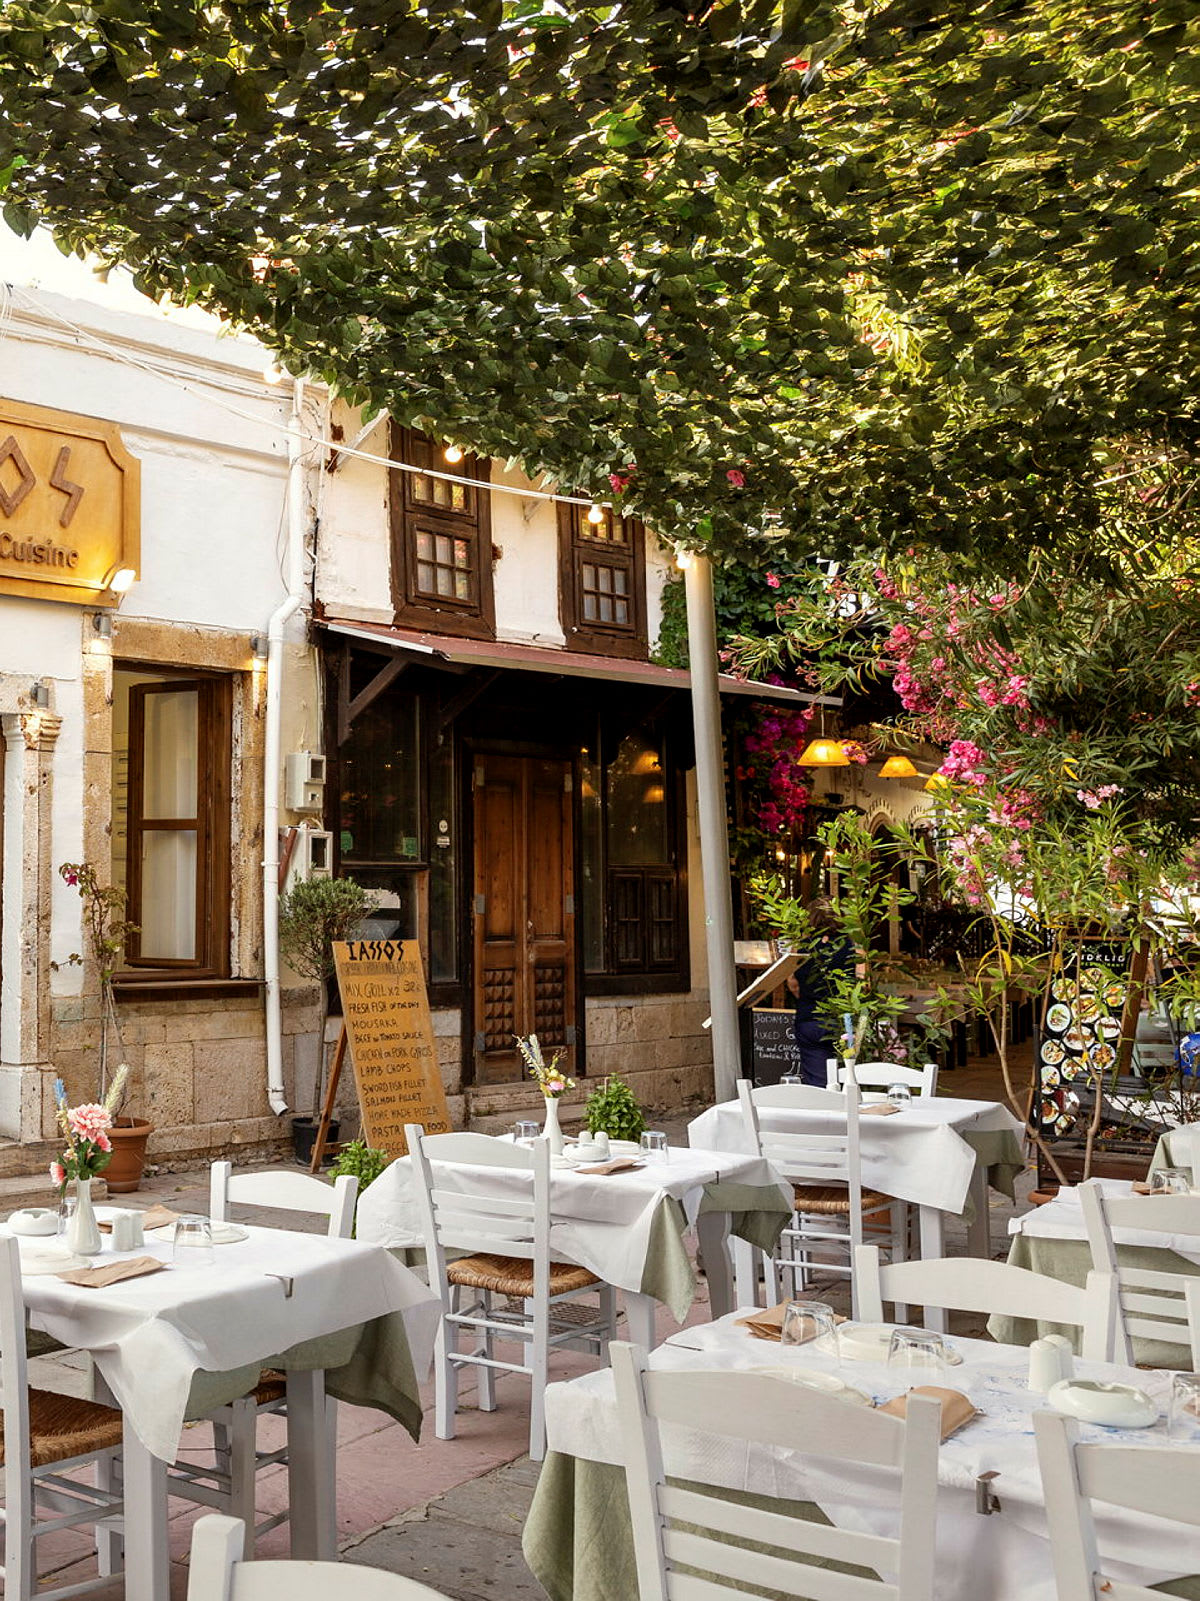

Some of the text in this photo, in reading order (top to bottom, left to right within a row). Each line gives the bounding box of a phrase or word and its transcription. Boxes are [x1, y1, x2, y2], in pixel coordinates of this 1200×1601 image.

[345, 940, 405, 961] IASSOS
[345, 983, 362, 998] MIX
[349, 1002, 370, 1014] FRESH
[371, 1001, 387, 1013] FISH
[360, 1062, 412, 1077] LAMB CHOPS
[365, 1095, 396, 1107] SALMON
[371, 1125, 401, 1138] PASTA
